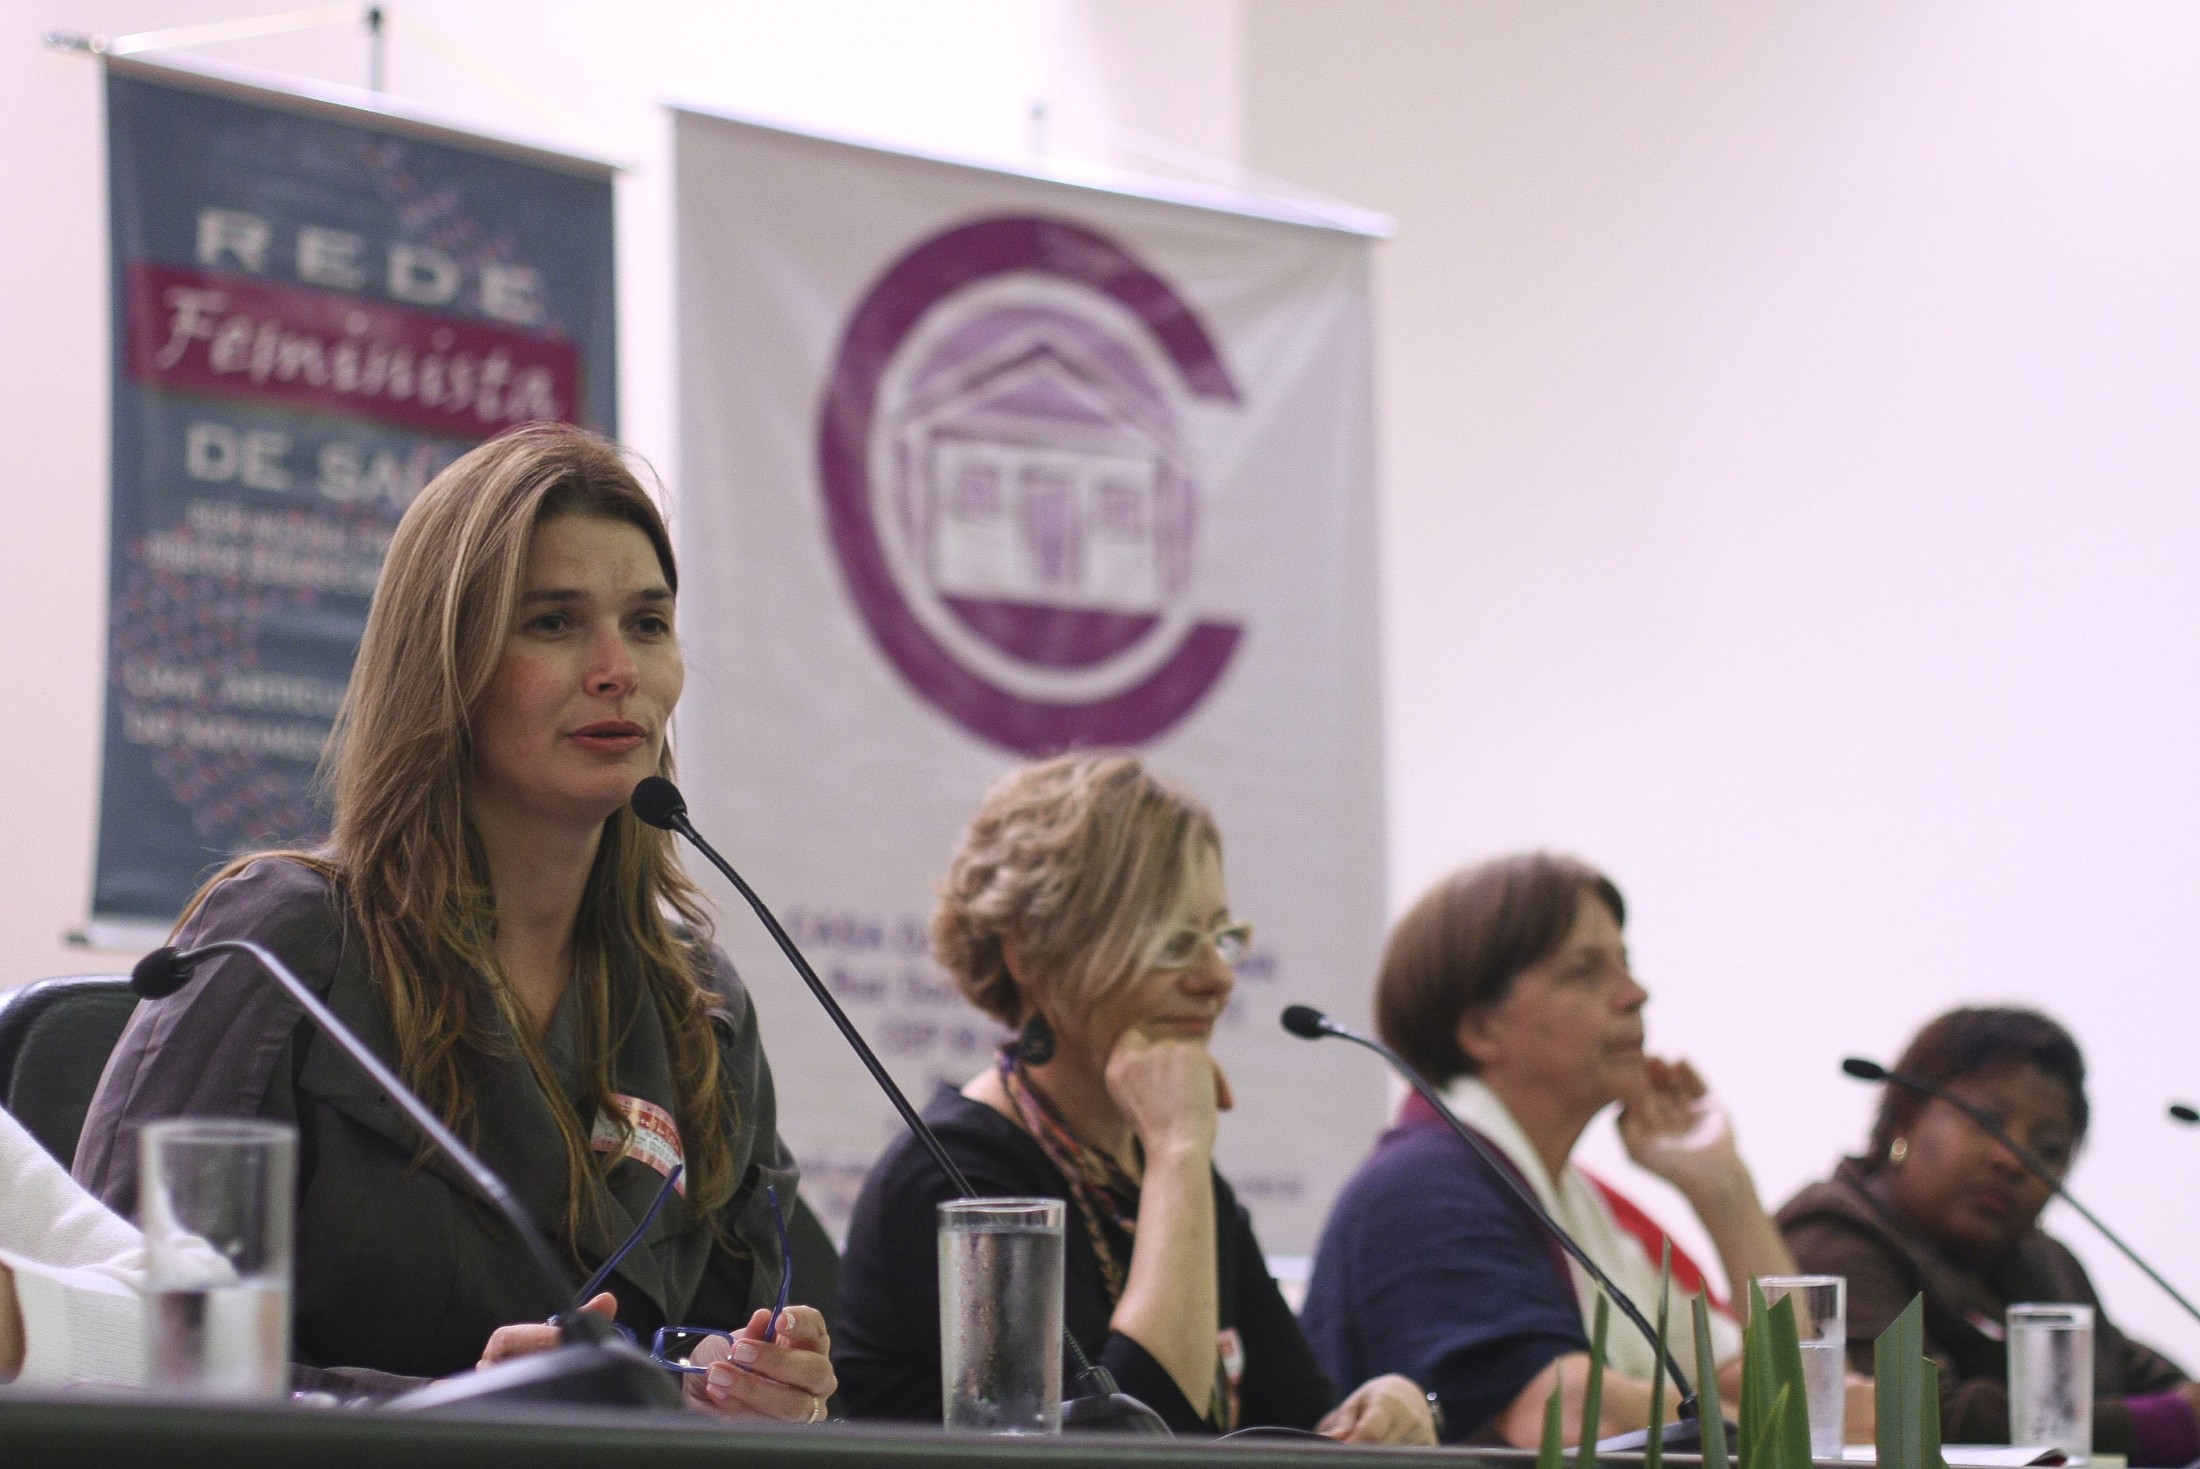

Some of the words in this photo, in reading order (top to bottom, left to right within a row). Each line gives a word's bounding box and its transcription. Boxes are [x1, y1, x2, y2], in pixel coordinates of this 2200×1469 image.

[199, 209, 543, 324] REDE
[156, 287, 560, 423] Feminista
[186, 422, 294, 492] DE
[317, 441, 428, 506] SA
